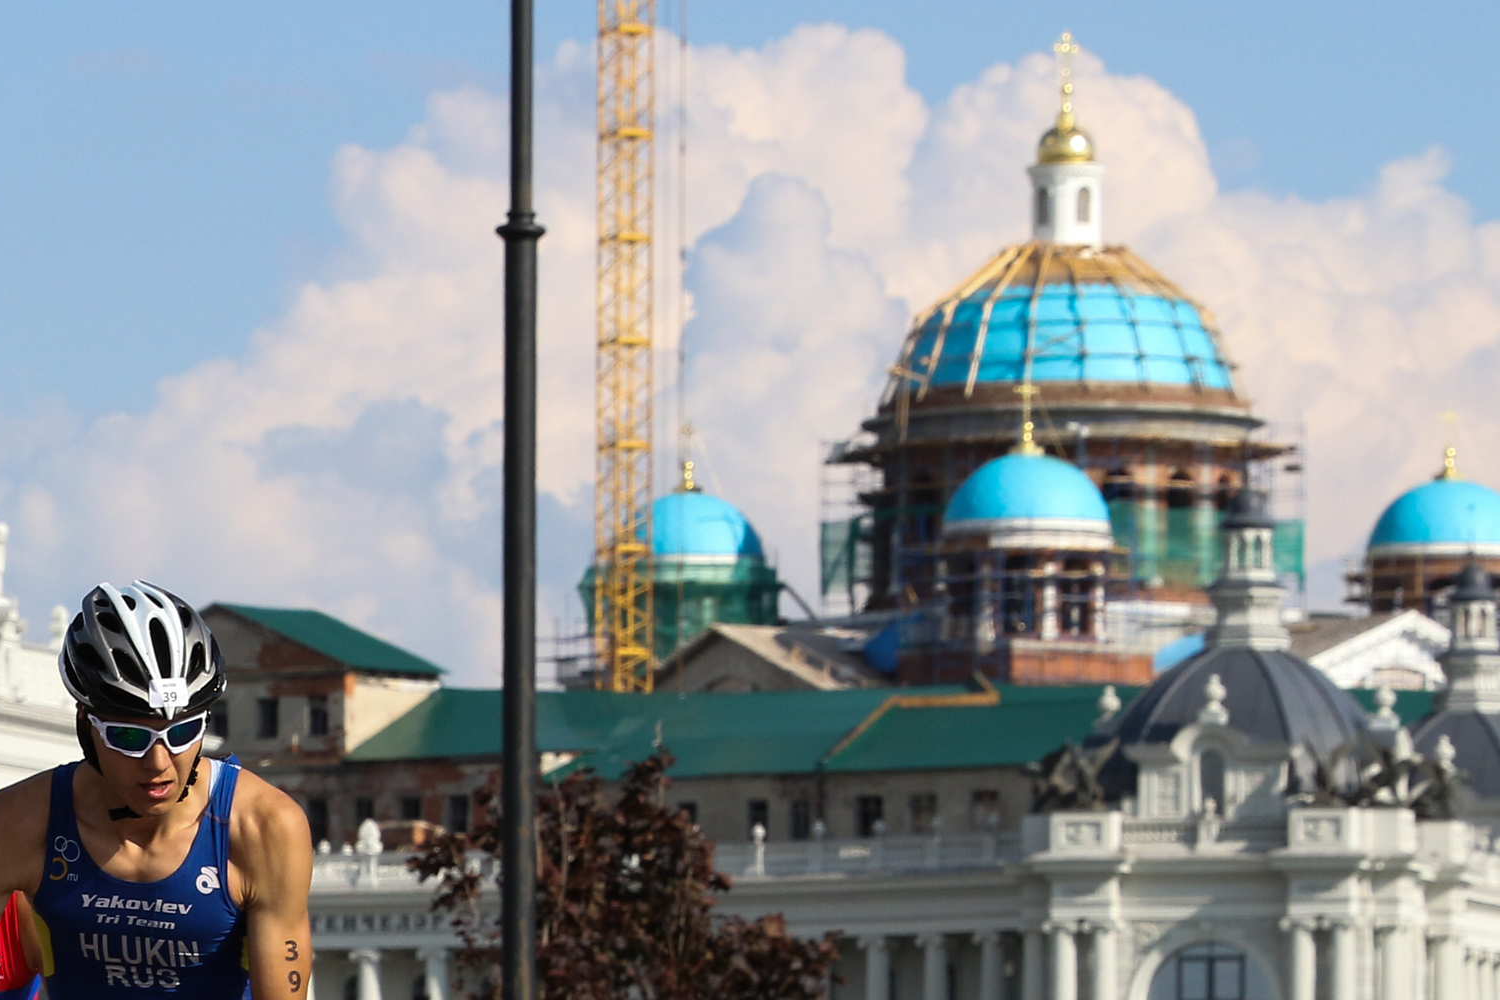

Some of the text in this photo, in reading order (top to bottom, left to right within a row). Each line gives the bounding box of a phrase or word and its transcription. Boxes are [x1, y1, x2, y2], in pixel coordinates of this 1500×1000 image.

[163, 691, 177, 703] 39
[66, 873, 79, 882] ITU
[81, 894, 193, 915] Yakovlev
[96, 913, 176, 930] Tri Team
[79, 933, 201, 967] HLUKIN
[105, 965, 181, 989] RUS
